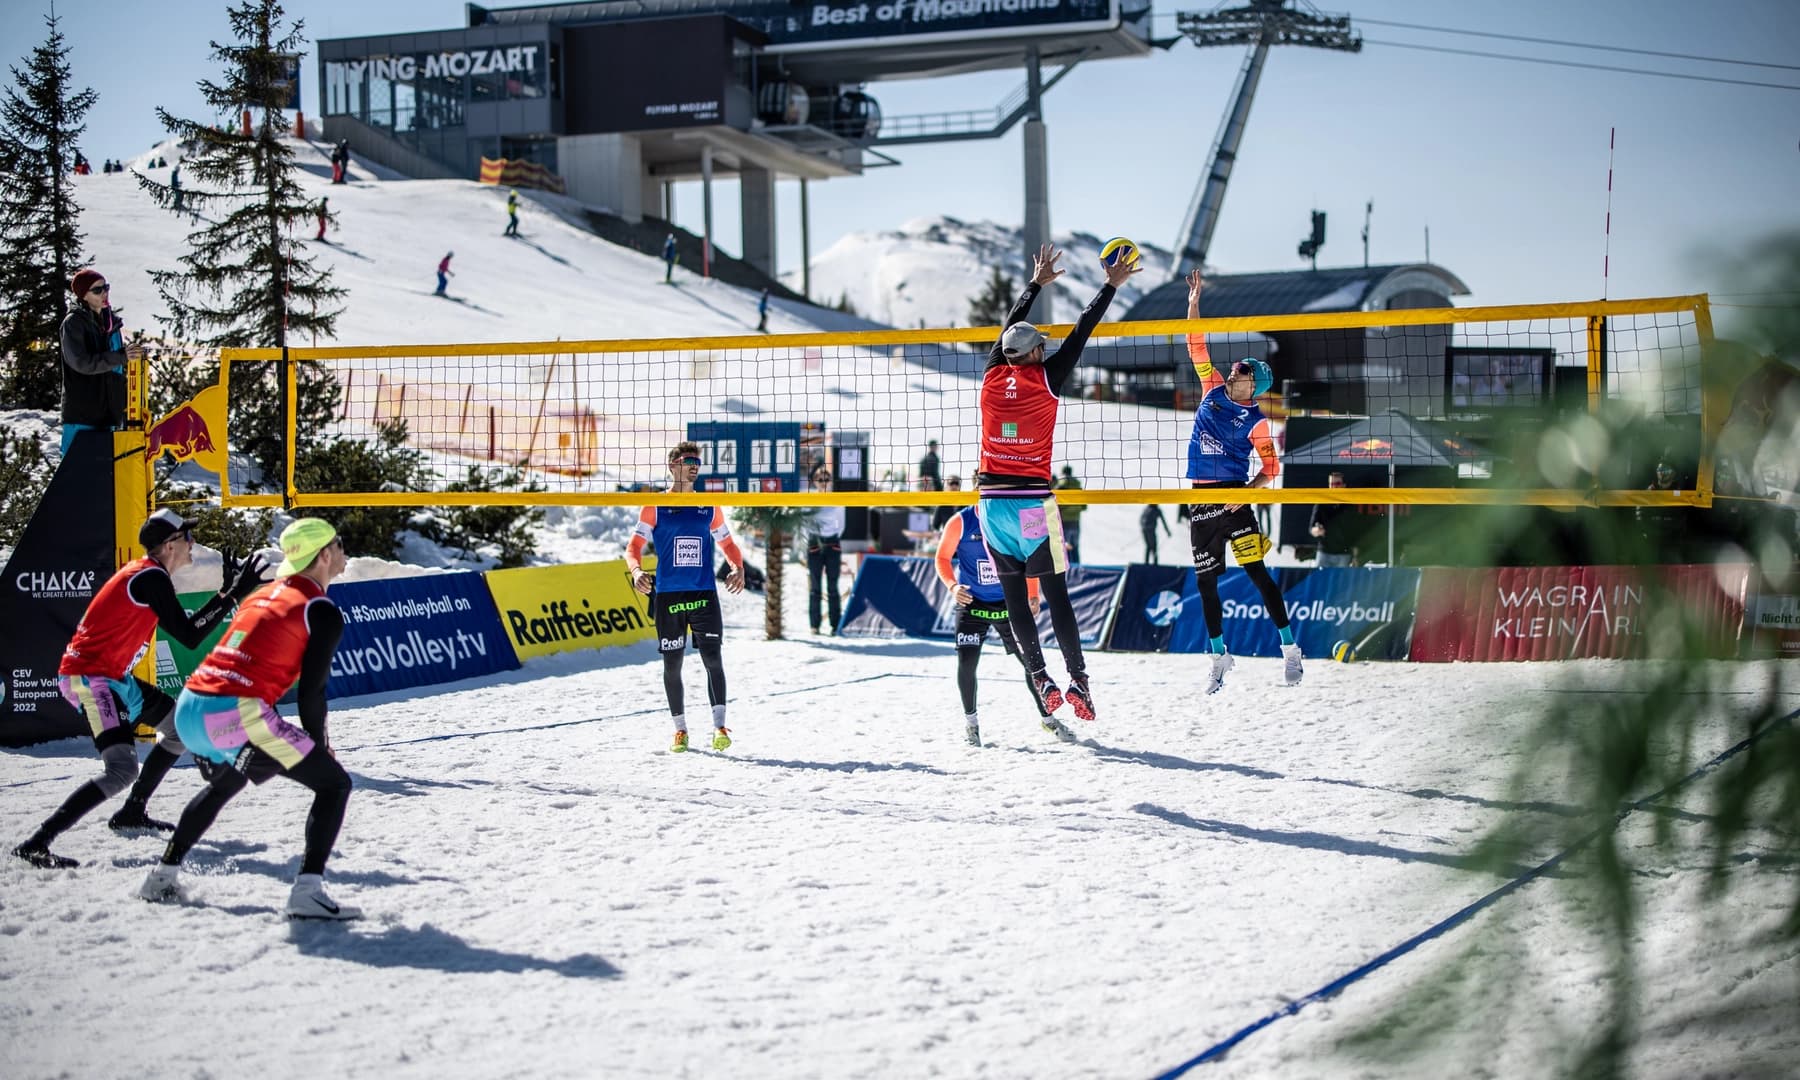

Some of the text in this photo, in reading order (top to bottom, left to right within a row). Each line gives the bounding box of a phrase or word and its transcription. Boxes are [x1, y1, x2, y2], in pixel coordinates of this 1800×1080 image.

[811, 0, 1061, 26] Best of Mountains
[424, 46, 538, 79] MOZART
[1006, 377, 1017, 390] 2
[1005, 391, 1017, 399] SUI
[1237, 408, 1249, 419] 2
[64, 590, 93, 598] FEELINGS
[352, 594, 453, 623] #SnowVolleyball
[454, 597, 472, 611] on
[506, 598, 644, 646] Raiffeisen
[1761, 612, 1793, 624] Nicht
[12, 669, 32, 678] CEV
[12, 678, 62, 688] Snow Voll
[13, 690, 59, 701] European
[13, 703, 37, 712] 2022
